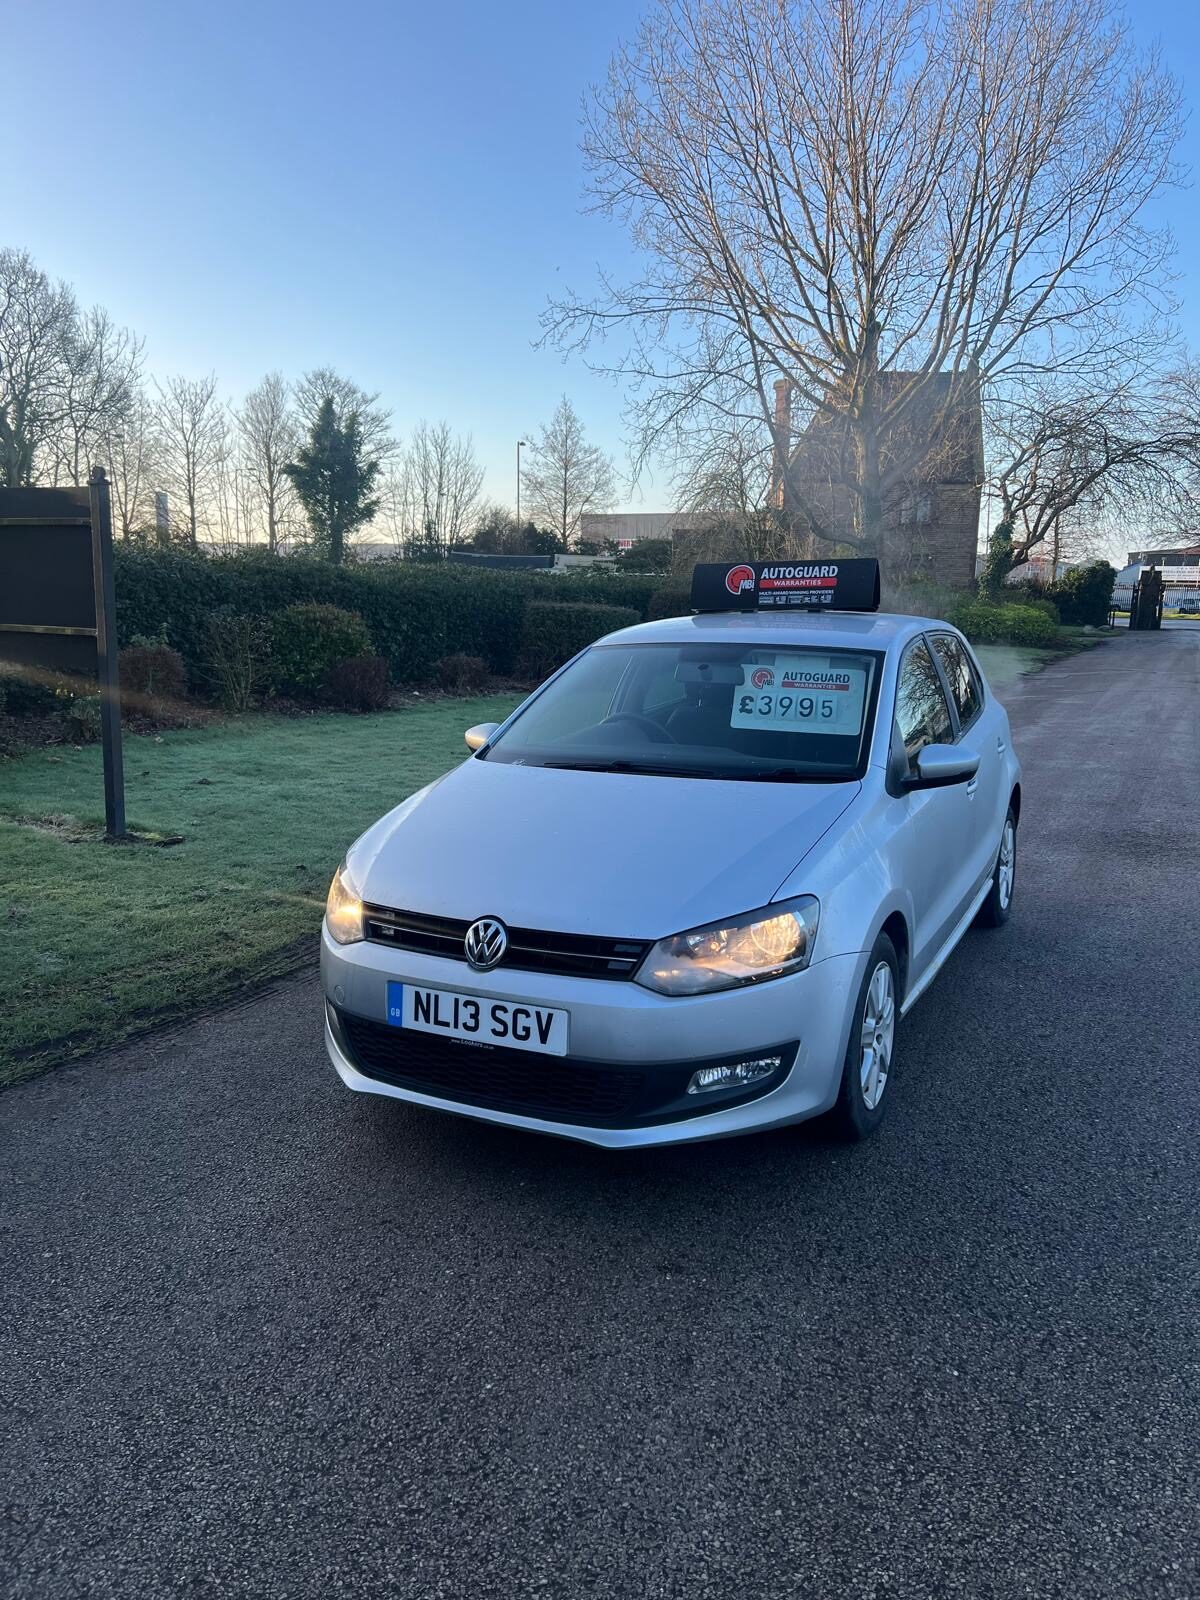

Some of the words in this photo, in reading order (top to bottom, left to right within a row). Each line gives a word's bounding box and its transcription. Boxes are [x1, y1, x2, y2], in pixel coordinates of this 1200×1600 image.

[761, 565, 838, 579] AUTOGUARD
[773, 579, 822, 587] WARRANTIES
[782, 671, 850, 684] AUTOGUARD
[794, 682, 836, 690] WARRANTIES
[738, 695, 833, 719] £3995
[390, 1007, 401, 1017] GB
[414, 990, 480, 1033] NL13
[490, 1004, 553, 1045] SGV
